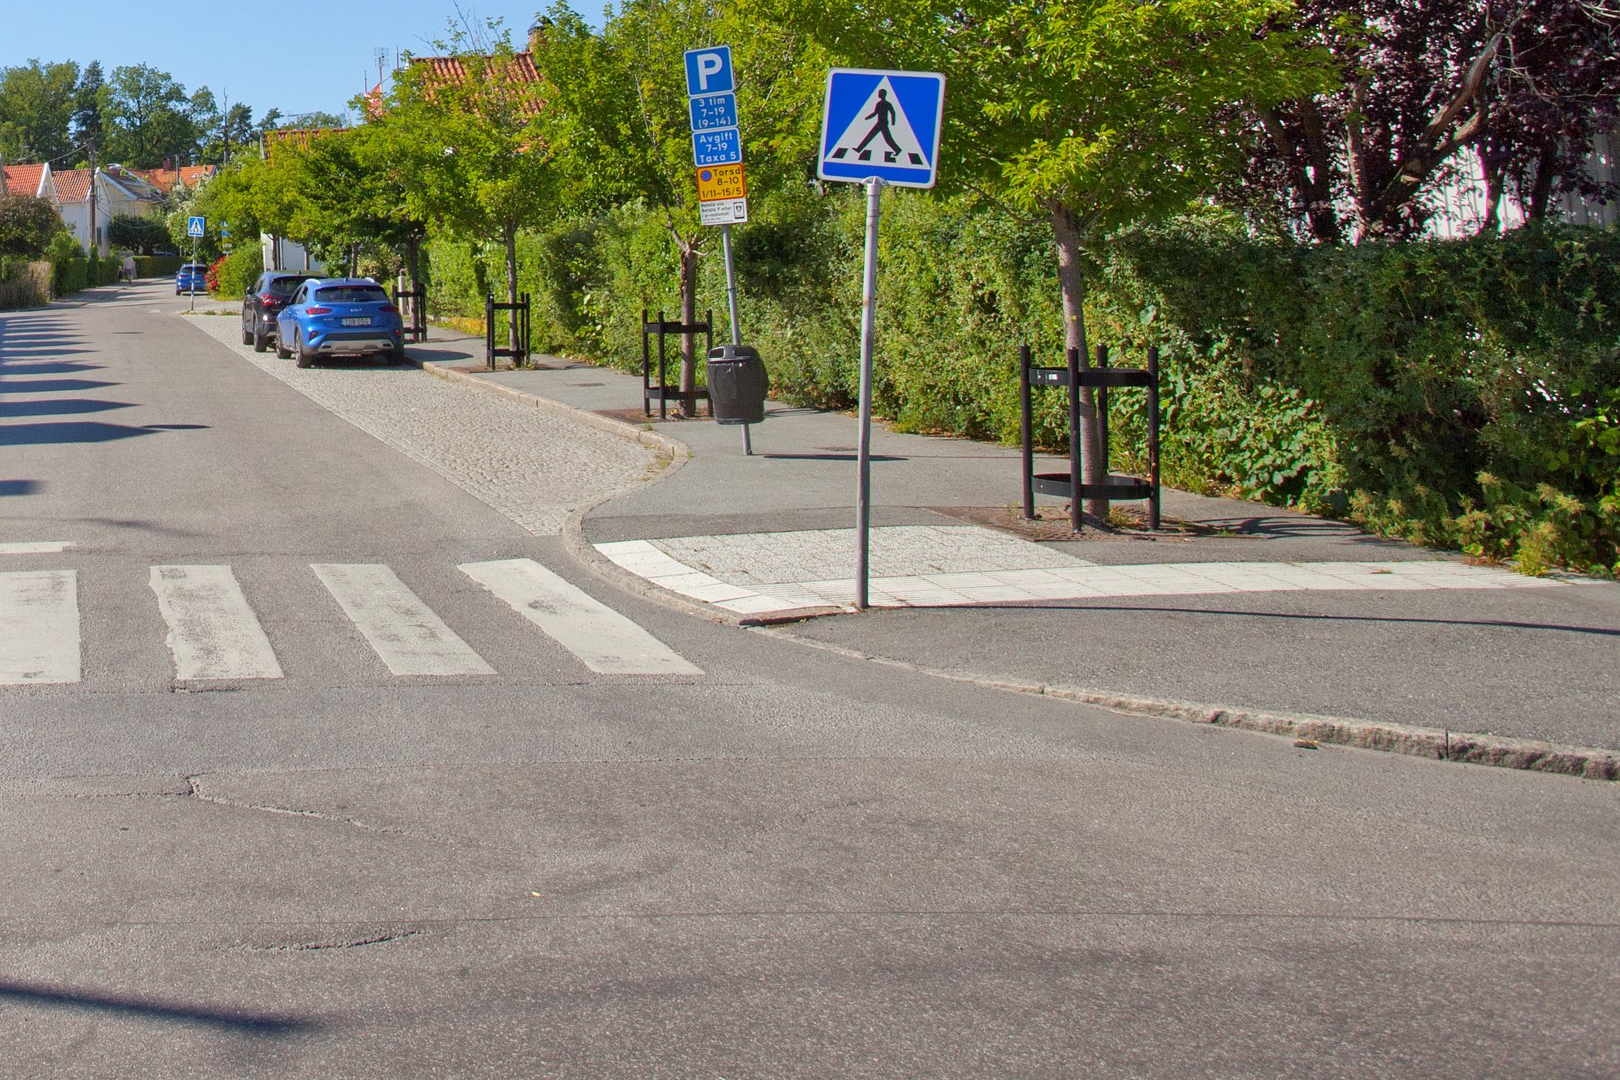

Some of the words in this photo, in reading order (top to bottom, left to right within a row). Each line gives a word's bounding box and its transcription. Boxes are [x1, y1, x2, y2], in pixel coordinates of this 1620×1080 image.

[697, 53, 723, 90] P
[699, 99, 705, 107] 3
[709, 97, 726, 106] tim
[701, 106, 725, 117] 7-19
[698, 116, 731, 128] (9-14)
[700, 132, 733, 144] Avgift
[706, 142, 728, 153] 7-19
[700, 153, 726, 163] Taxa
[730, 151, 737, 160] 5
[713, 167, 741, 177] Torsd
[717, 176, 739, 186] 8-10
[702, 186, 742, 199] 1/11-15/5
